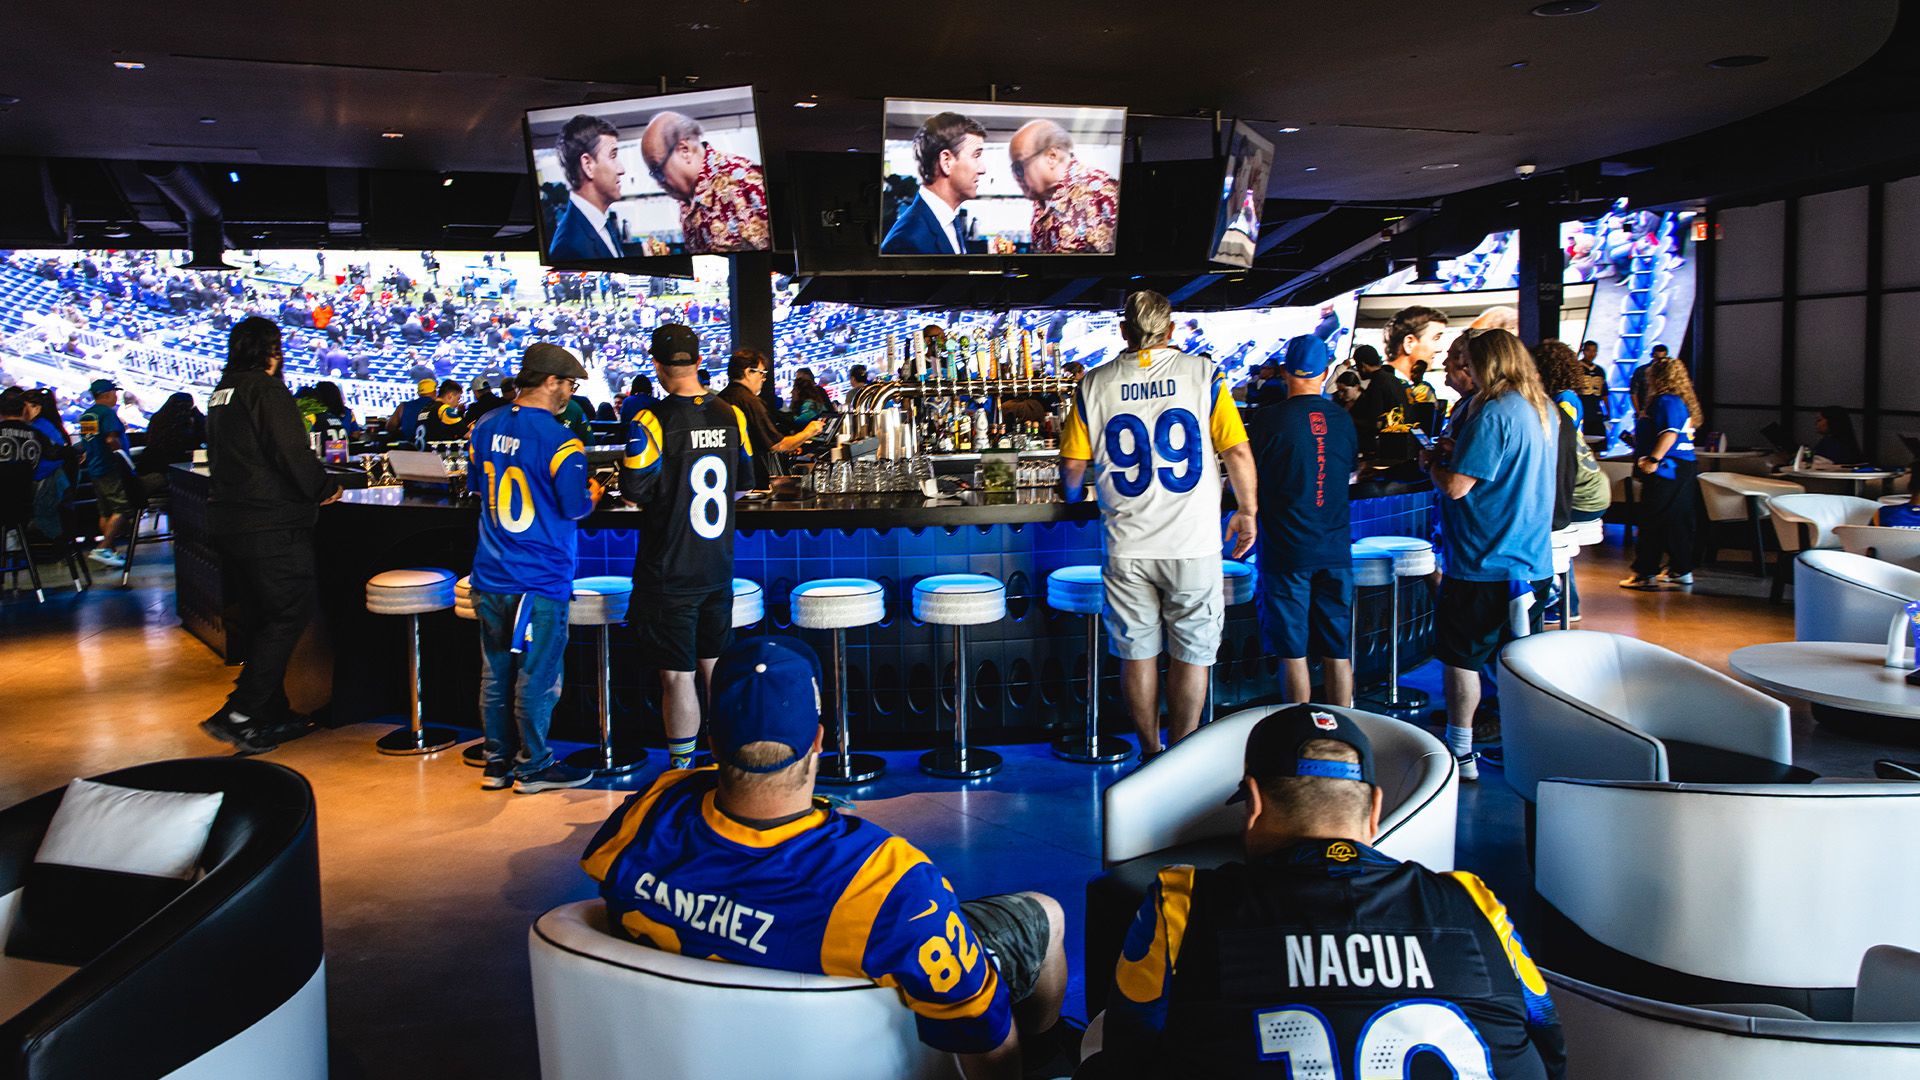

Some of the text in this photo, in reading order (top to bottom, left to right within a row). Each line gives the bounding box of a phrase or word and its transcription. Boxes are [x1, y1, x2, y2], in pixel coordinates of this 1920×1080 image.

[1120, 378, 1176, 401] DONALD
[491, 433, 521, 457] KUPP
[690, 428, 727, 449] VERSE
[1105, 407, 1203, 498] 99
[483, 460, 536, 534] 10
[688, 454, 728, 541] 8
[634, 872, 775, 955] SANCHEZ
[918, 910, 979, 994] 82
[1285, 933, 1435, 989] NACUA
